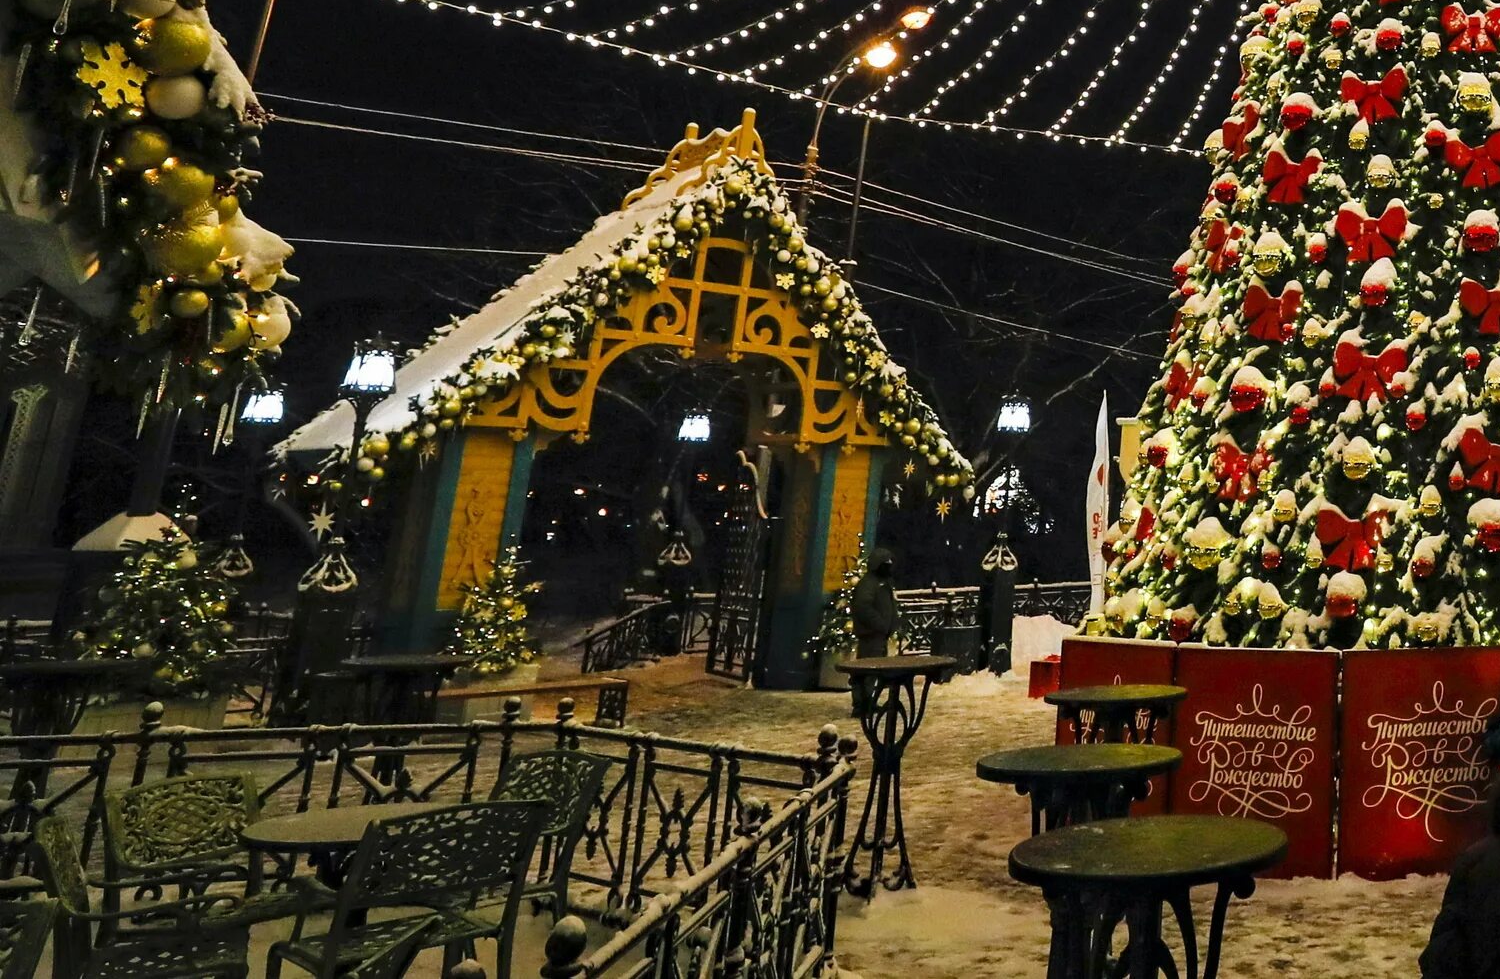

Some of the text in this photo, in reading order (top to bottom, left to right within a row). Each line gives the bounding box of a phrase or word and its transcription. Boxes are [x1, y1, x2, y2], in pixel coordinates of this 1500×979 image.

[1190, 705, 1317, 746] Путешествие
[1363, 702, 1491, 748] Путешеств
[1197, 741, 1305, 794] Рождество
[1370, 742, 1491, 798] Рождество
